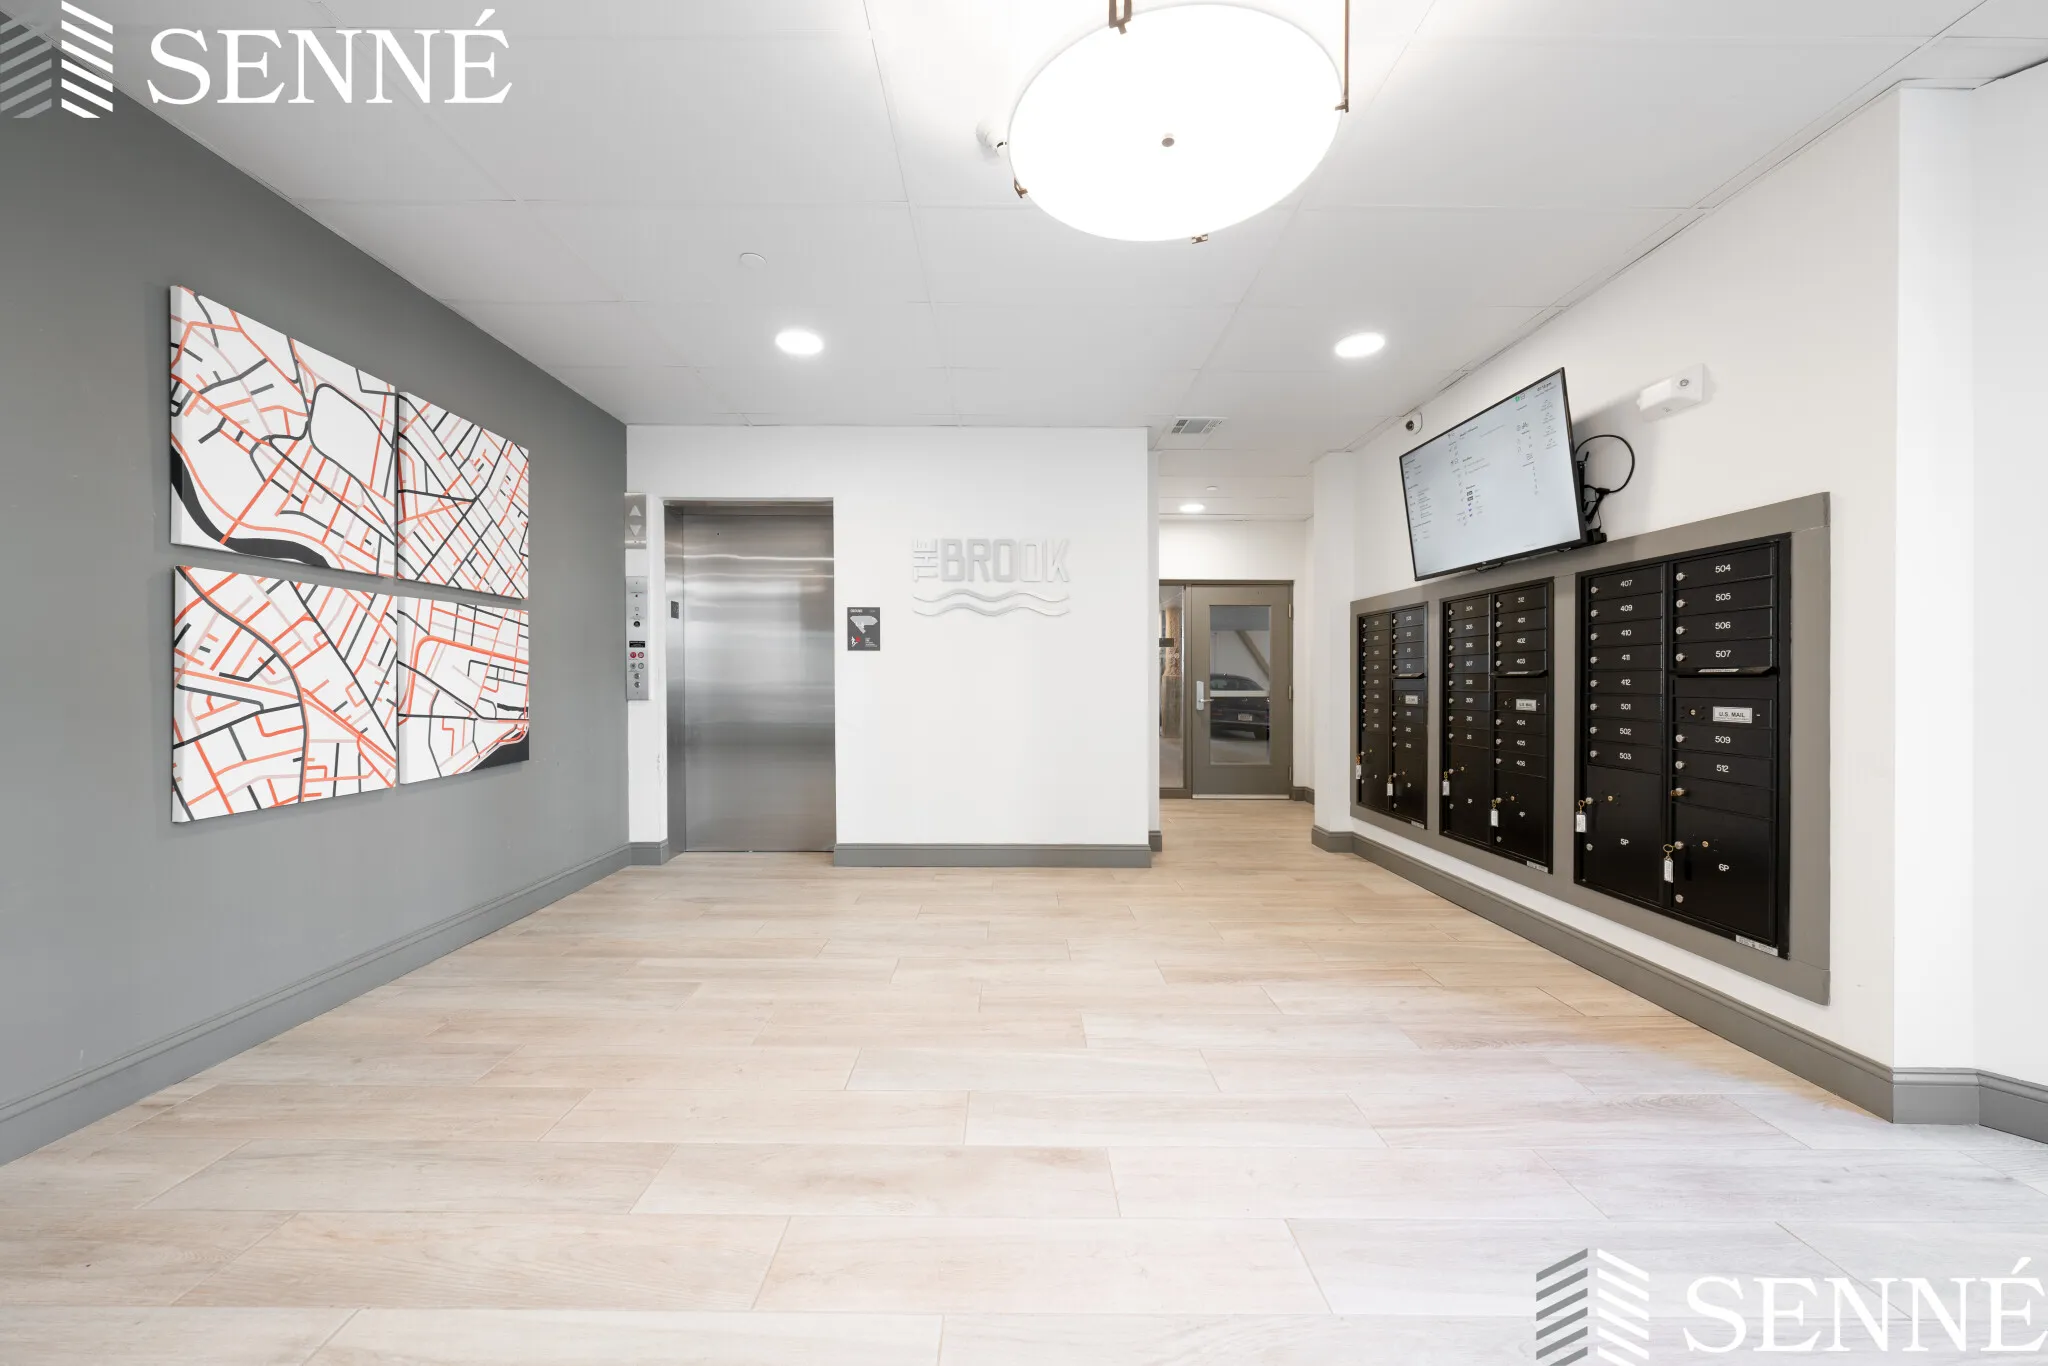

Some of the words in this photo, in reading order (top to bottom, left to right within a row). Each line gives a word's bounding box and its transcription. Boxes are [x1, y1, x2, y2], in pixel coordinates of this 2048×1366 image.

[912, 538, 938, 582] THE
[940, 538, 1071, 582] BROOK
[1714, 564, 1732, 574] 504
[1620, 580, 1632, 588] 407
[1716, 592, 1732, 602] 505
[1714, 622, 1730, 630] 506
[1716, 650, 1732, 658] 507
[1620, 728, 1632, 736] 502
[1714, 736, 1730, 744] 509
[1620, 752, 1632, 760] 503
[1716, 764, 1730, 772] 512
[1718, 864, 1730, 872] 6P
